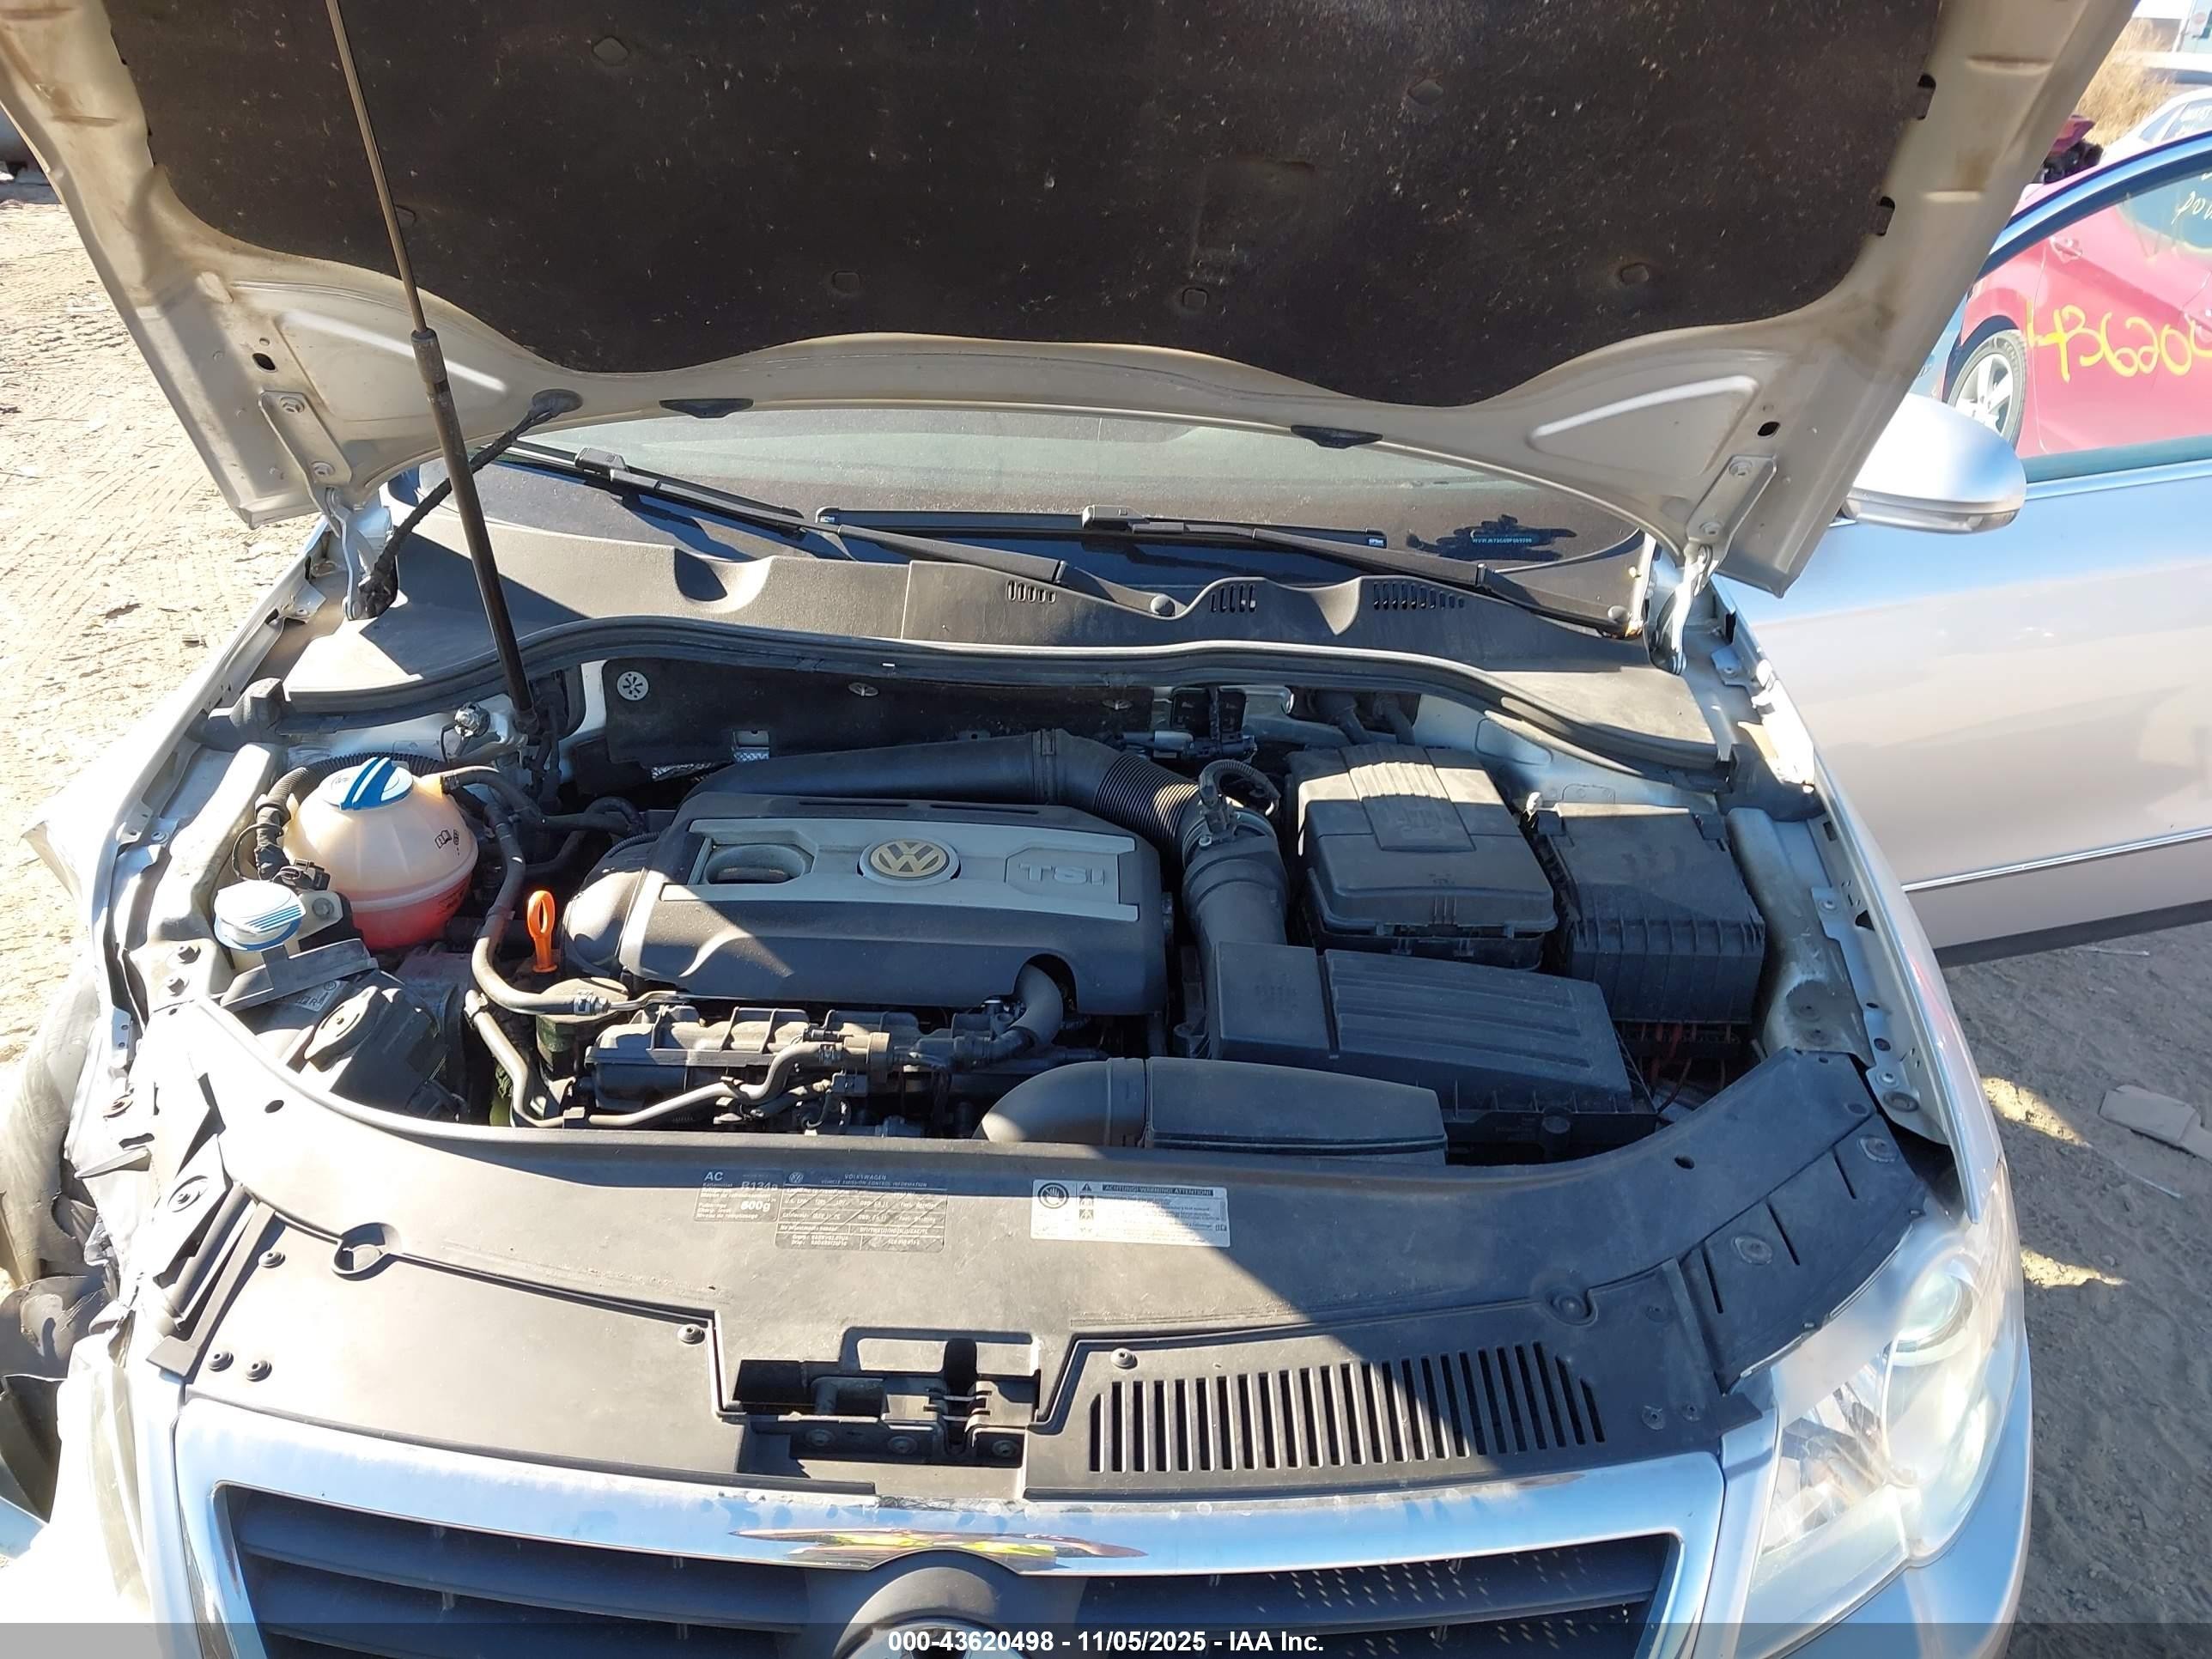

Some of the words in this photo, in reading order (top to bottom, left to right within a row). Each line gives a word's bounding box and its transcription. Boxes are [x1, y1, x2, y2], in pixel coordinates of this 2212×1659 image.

[1018, 863, 1106, 887] TSI
[704, 1171, 724, 1182] AC
[1174, 1188, 1212, 1196] ATTENTION!
